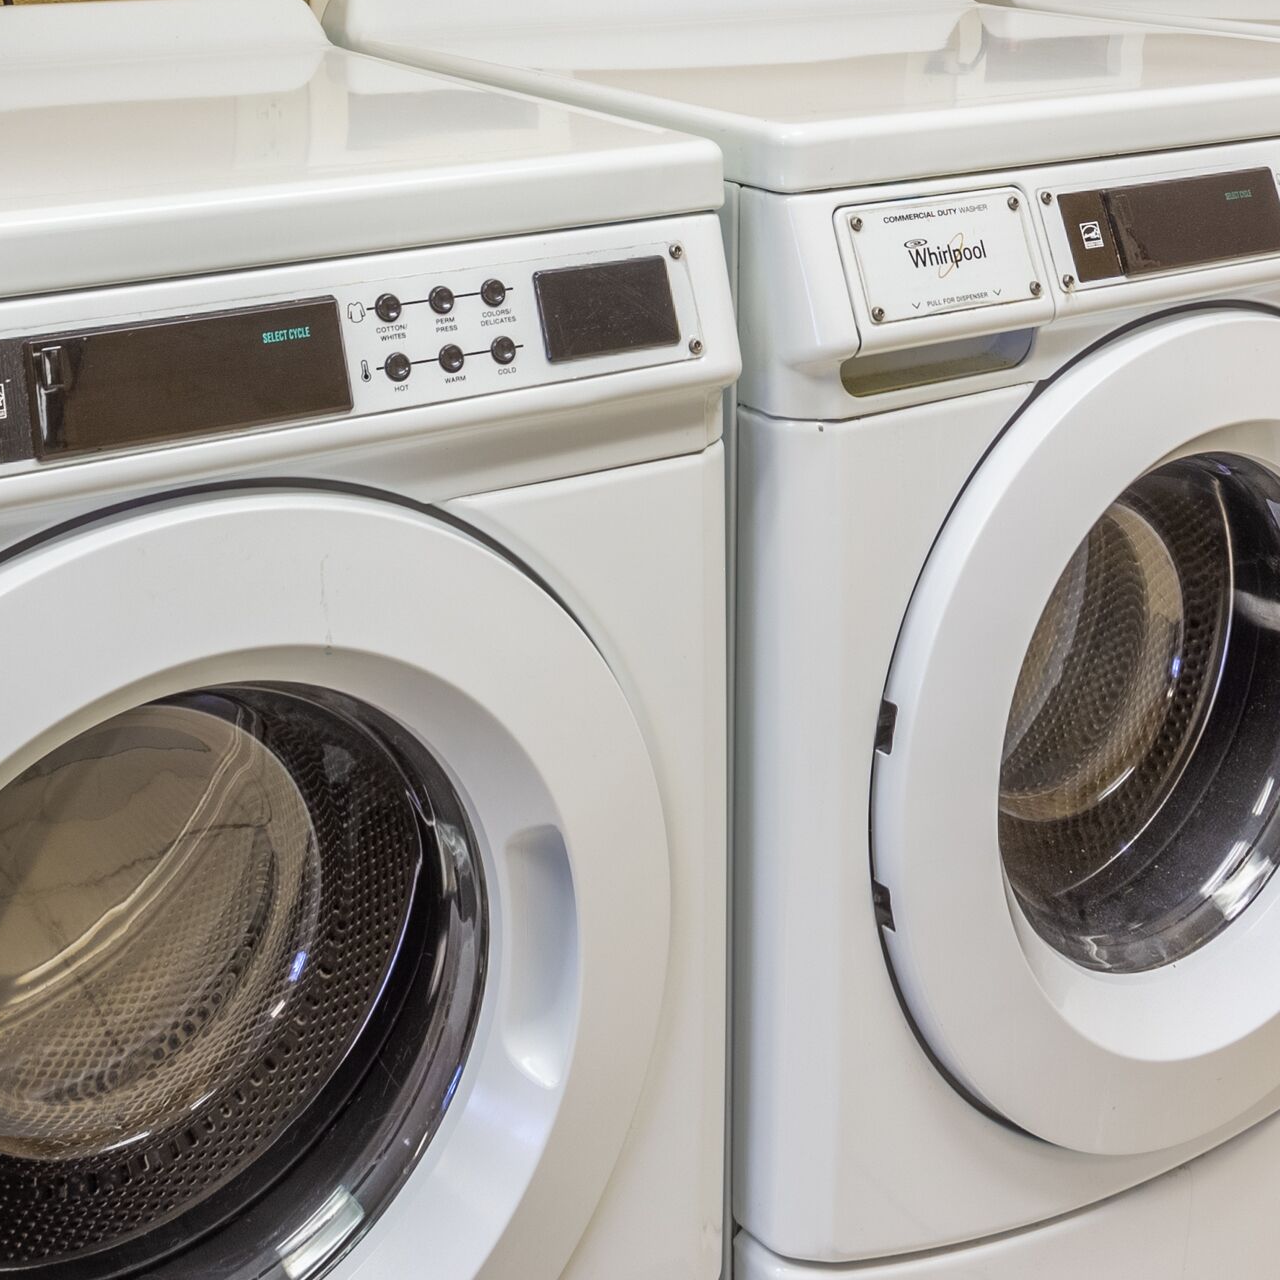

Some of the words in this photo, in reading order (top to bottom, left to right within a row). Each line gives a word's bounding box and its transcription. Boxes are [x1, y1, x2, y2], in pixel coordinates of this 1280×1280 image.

[883, 211, 935, 224] COMMERCIAL
[937, 207, 957, 217] DUTY
[958, 203, 988, 214] WASHER
[908, 239, 987, 269] Whirlpool
[926, 299, 941, 308] PULL
[943, 296, 955, 304] FOR
[956, 292, 988, 303] DISPENSER
[482, 308, 512, 318] COLORS/
[436, 317, 455, 325] PERM
[480, 316, 517, 327] DELICATES
[376, 324, 408, 334] COTTON/
[436, 325, 458, 333] PRESS
[262, 330, 288, 344] SELECT
[288, 326, 311, 340] CYCLE
[380, 333, 407, 342] WHITES
[498, 367, 517, 376] COLD
[444, 375, 466, 384] WARM
[394, 384, 409, 393] HOT
